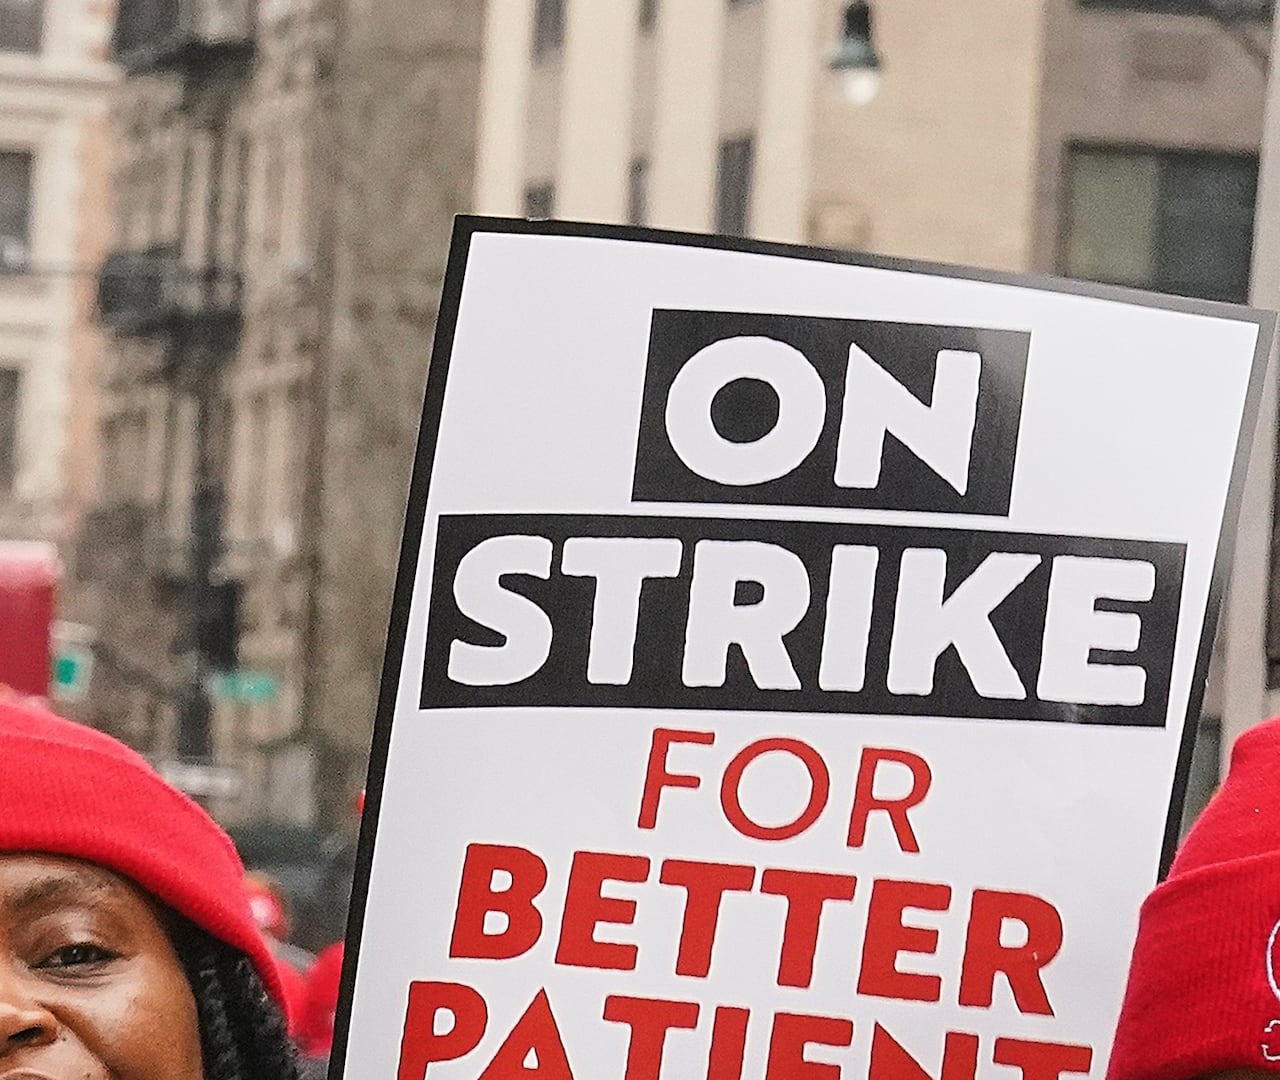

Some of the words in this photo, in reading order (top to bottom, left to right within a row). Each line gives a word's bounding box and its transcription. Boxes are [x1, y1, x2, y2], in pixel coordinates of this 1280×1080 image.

[665, 334, 981, 497] ON
[447, 534, 1157, 708] STRIKE
[637, 727, 933, 854] FOR
[448, 842, 1064, 1019] BETTER
